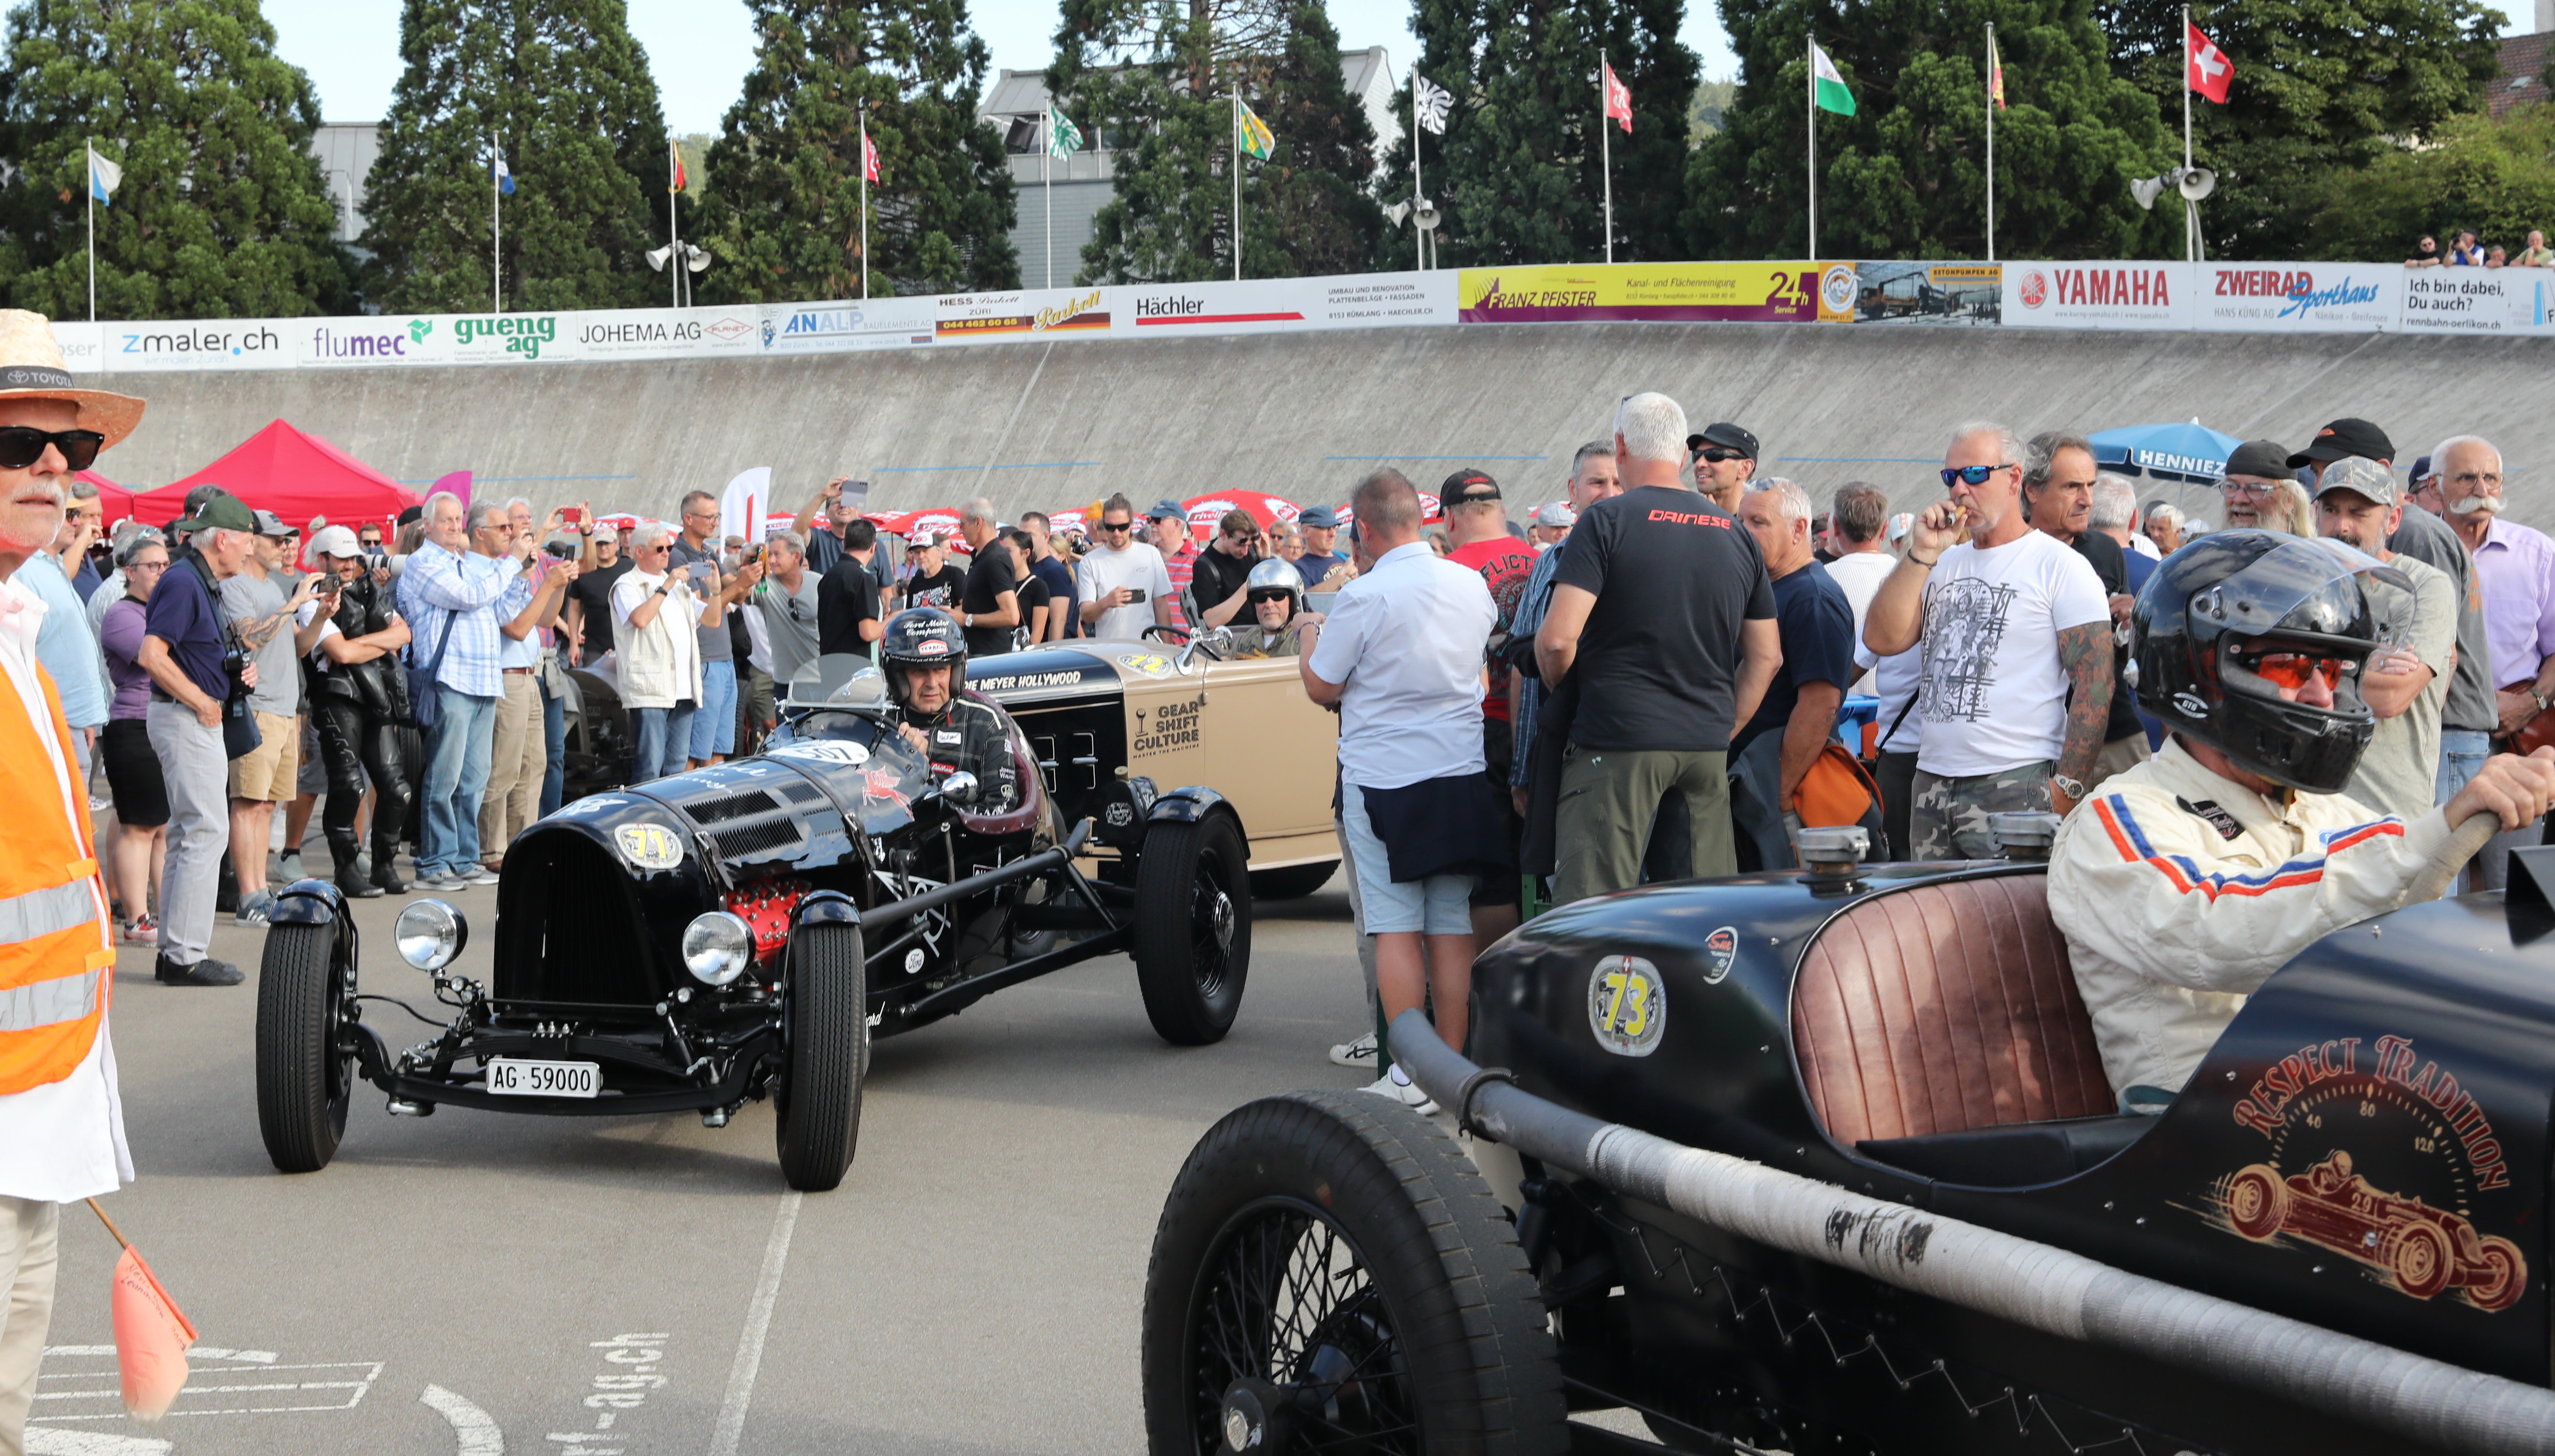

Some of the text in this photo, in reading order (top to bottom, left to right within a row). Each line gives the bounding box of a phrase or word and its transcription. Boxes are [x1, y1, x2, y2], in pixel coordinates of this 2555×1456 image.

[1372, 284, 1415, 292] RENOVATION
[1627, 278, 1736, 289] Kanal- und Flächenreinigung
[2054, 270, 2169, 306] YAMAHA
[2215, 271, 2312, 296] ZWEIRAD
[2410, 279, 2504, 297] Ich bin dabei,
[940, 295, 1020, 306] HESS Parkett
[1137, 295, 1204, 316] Hächler
[1328, 295, 1383, 304] PLATTENBELÄGE
[1489, 291, 1597, 308] FRANZ PFISTER
[2277, 276, 2379, 319] Sporthaus
[2408, 296, 2473, 311] Du auch?
[968, 307, 992, 316] ZÜRI
[1032, 290, 1102, 331] Parkett
[1388, 307, 1433, 316] HAECHLER.CH
[1774, 305, 1797, 314] Service
[2214, 306, 2274, 319] HANS KÜNG AG
[784, 311, 864, 333] ANALP
[864, 320, 918, 330] BAUELEMENTE
[943, 320, 964, 329] 044
[965, 320, 986, 328] 462
[988, 319, 1002, 327] 60
[2407, 317, 2501, 330] rennbahn-oerlikon.ch
[454, 317, 556, 345] gueng
[580, 322, 701, 344] JOHEMA AG
[122, 327, 278, 355] zmaler.ch
[313, 328, 405, 357] flumec
[506, 336, 539, 359] ag
[162, 355, 194, 364] malen
[197, 354, 229, 363] Zürich
[31, 372, 73, 388] TOYOTA
[2139, 450, 2227, 475] HENNIEZ
[1648, 509, 1731, 530] DAINESE
[904, 619, 950, 629] Ford Motor
[906, 627, 947, 637] Company
[1129, 654, 1163, 673] 72
[980, 676, 1016, 692] MEYER
[1018, 671, 1081, 688] HOLLYWOOD
[1158, 701, 1199, 718] GEAR
[1156, 715, 1199, 733] SHIFT
[1134, 729, 1200, 751] CULTURE
[1133, 750, 1156, 759] MASTER
[1172, 743, 1199, 753] MACHINE
[629, 830, 667, 858] 71
[908, 953, 923, 969] Ford
[1603, 972, 1648, 1037] 73
[494, 1066, 591, 1091] AG 59000
[2233, 1034, 2510, 1191] RESPECT TRADITION
[2360, 1101, 2376, 1117] 80
[2305, 1114, 2322, 1128] 40
[2414, 1136, 2435, 1153] 120
[2351, 1192, 2372, 1212] 29
